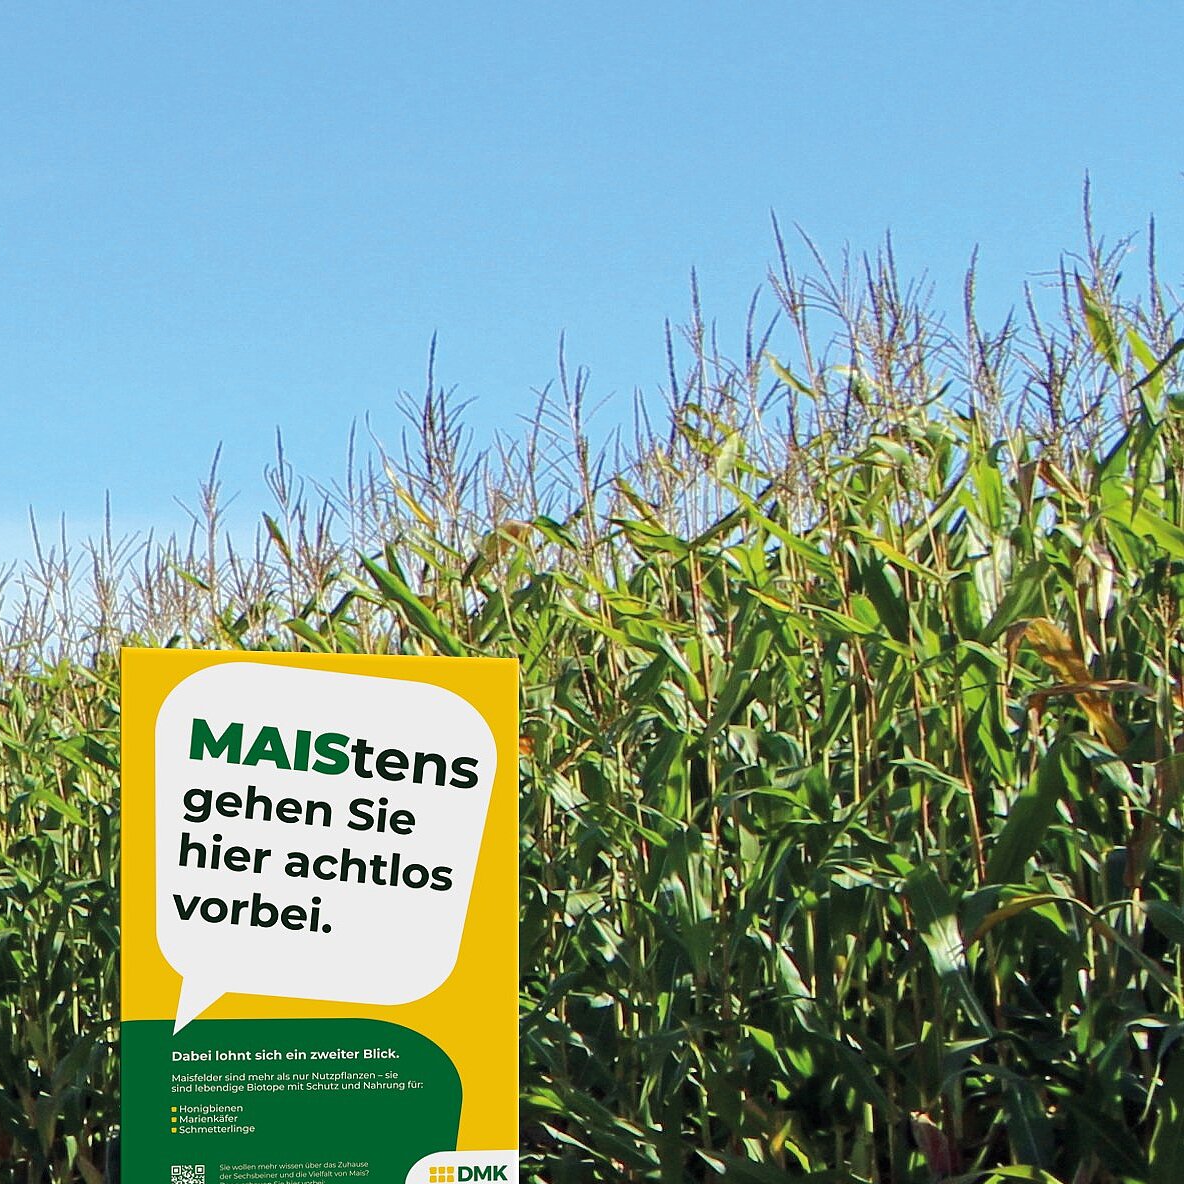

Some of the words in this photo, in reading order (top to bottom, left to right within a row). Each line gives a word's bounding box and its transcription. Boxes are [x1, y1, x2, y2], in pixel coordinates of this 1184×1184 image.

[189, 717, 480, 789] MAIStens
[182, 785, 332, 827] gehen
[347, 797, 416, 835] Sie
[178, 832, 271, 874] hier
[284, 848, 453, 891] achtlos
[172, 892, 332, 933] vorbei.
[172, 1050, 212, 1061] Dabei
[216, 1050, 252, 1061] lohnt
[255, 1049, 282, 1060] sich
[286, 1049, 307, 1060] ein
[310, 1048, 360, 1060] zweiter
[363, 1048, 400, 1059] Blick.
[171, 1073, 222, 1082] Maisfelder
[225, 1072, 246, 1082] sind
[248, 1072, 275, 1081] mehr
[276, 1072, 291, 1081] als
[312, 1071, 376, 1082] Nutzpflanzen
[385, 1071, 399, 1079] sie
[171, 1084, 192, 1093] sind
[195, 1083, 245, 1094] lebendige
[247, 1083, 285, 1092] Biotope
[287, 1082, 304, 1091] mit
[306, 1082, 339, 1091] Schutz
[341, 1081, 361, 1089] und
[363, 1081, 405, 1091] Nahrung
[407, 1080, 424, 1089] für:
[179, 1104, 244, 1114] Honigbienen
[179, 1114, 238, 1124] Marienkäfer
[179, 1124, 256, 1134] Schmetterlinge
[219, 1163, 231, 1171] Sie
[232, 1163, 256, 1171] wollen
[279, 1162, 303, 1170] wissen
[323, 1161, 336, 1169] das
[219, 1172, 232, 1180] der
[279, 1171, 295, 1179] und
[295, 1170, 307, 1178] die
[308, 1170, 333, 1178] Vielfalt
[349, 1169, 370, 1177] Mais?
[458, 1165, 508, 1182] DMK
